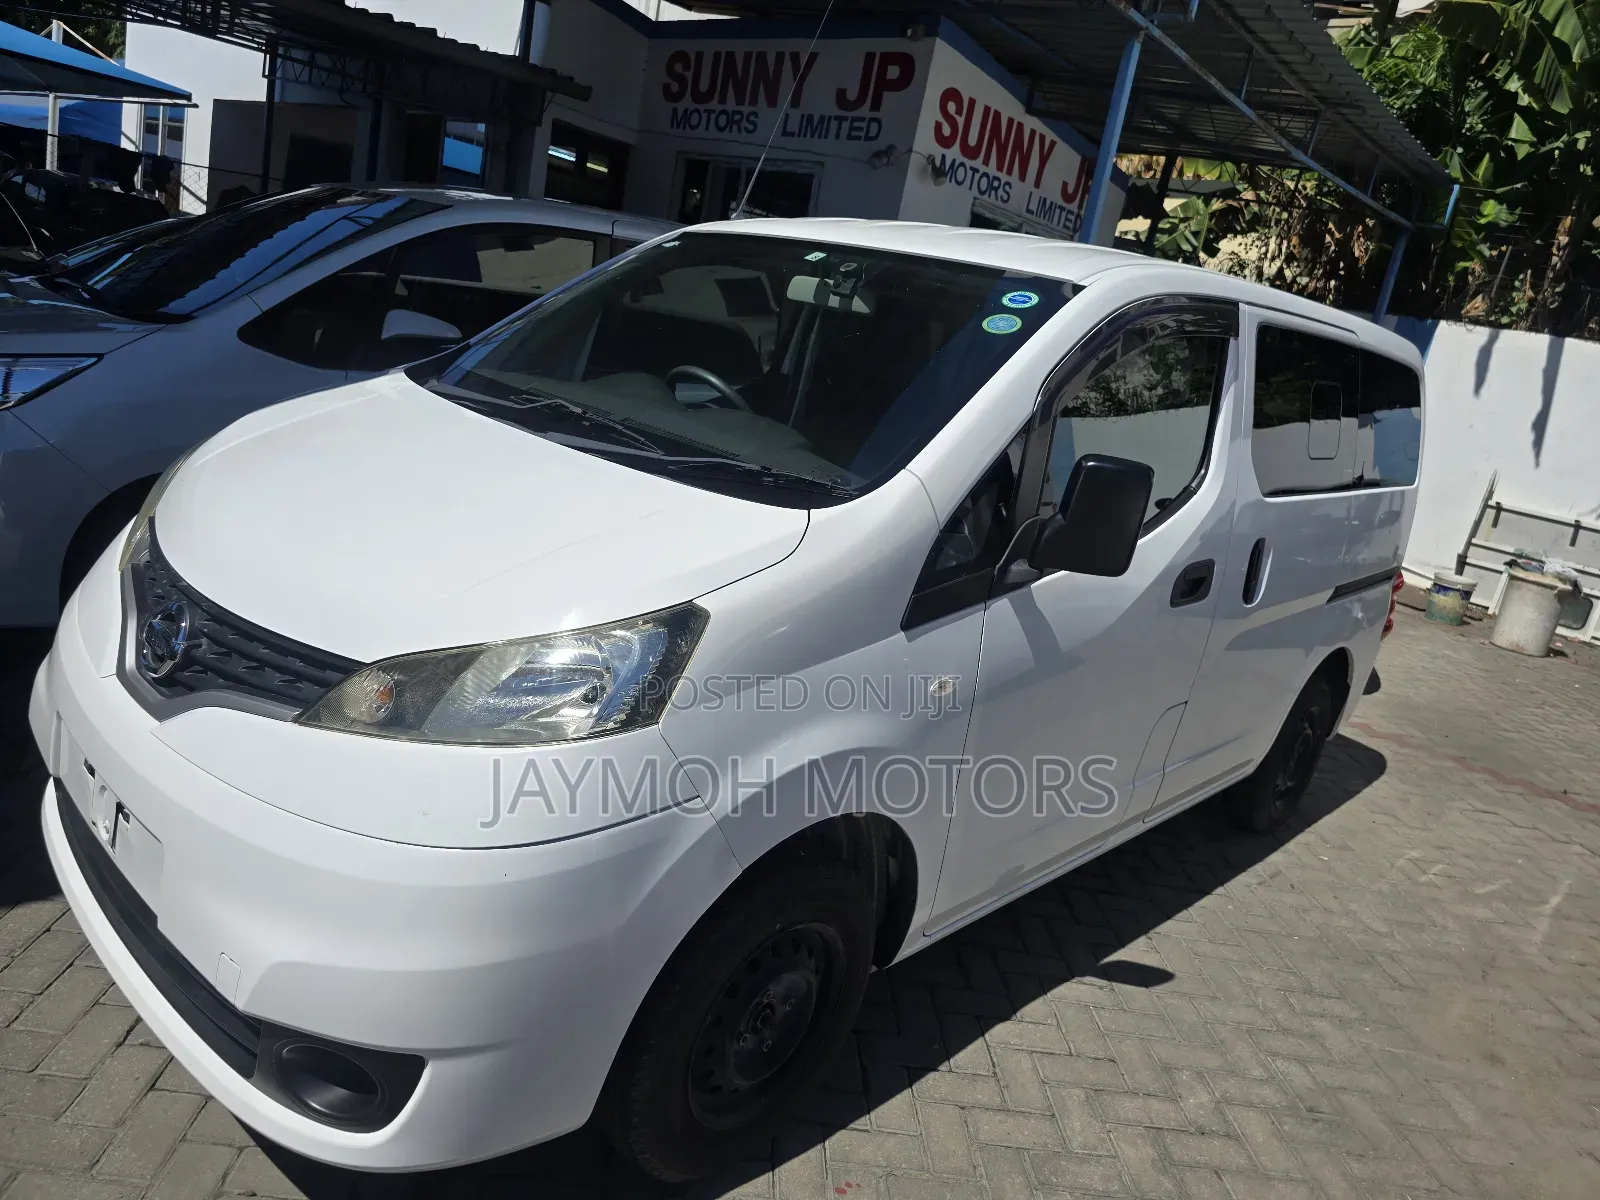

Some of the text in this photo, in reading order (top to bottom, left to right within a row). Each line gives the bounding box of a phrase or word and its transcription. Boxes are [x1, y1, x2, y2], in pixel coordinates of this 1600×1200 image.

[662, 50, 916, 113] SUNNY JP
[670, 107, 883, 143] MOTORS LIMITED
[934, 86, 1058, 190] SUNNY
[938, 153, 1083, 234] MOTORS LIMITED
